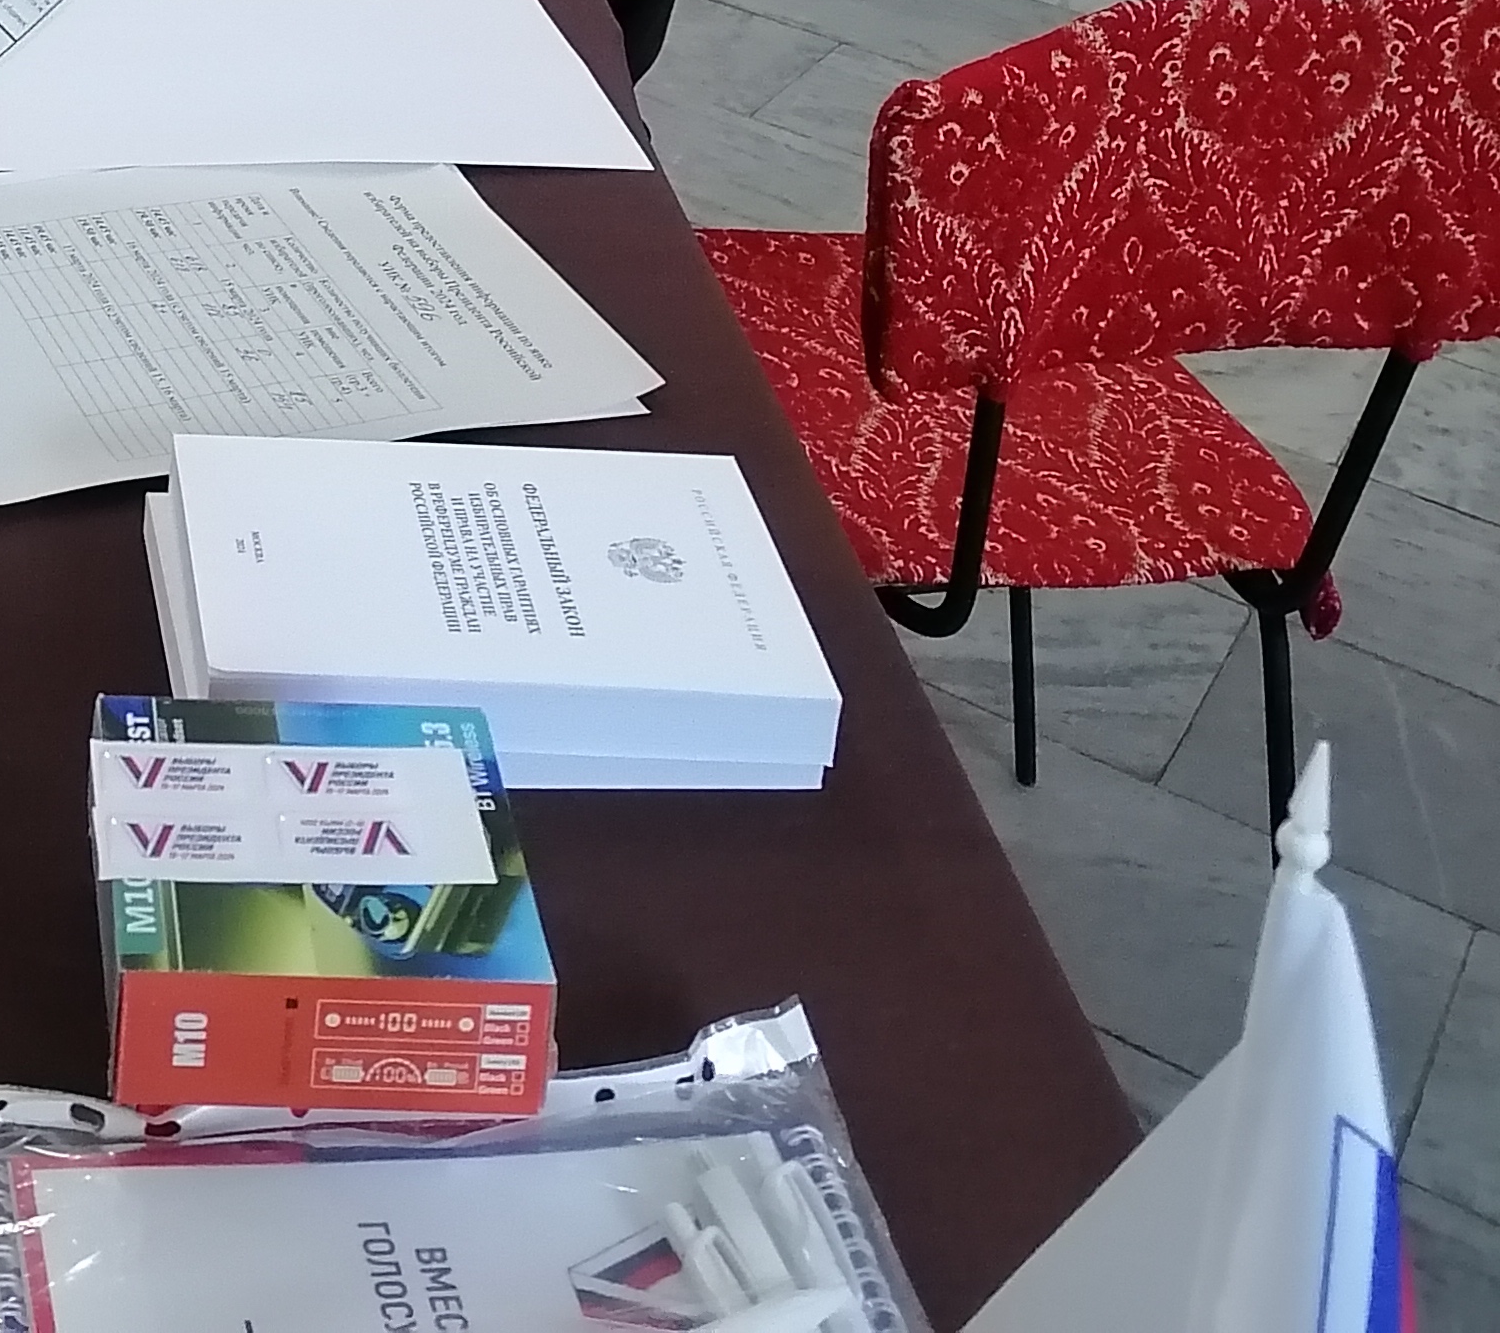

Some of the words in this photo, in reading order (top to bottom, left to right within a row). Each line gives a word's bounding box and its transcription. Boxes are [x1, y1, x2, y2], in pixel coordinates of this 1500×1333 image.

[363, 191, 414, 238] избирателей
[405, 238, 421, 248] на
[415, 249, 450, 280] выборы
[444, 280, 494, 329] Президента
[488, 328, 542, 381] Российской
[377, 261, 404, 282] УИК
[388, 195, 416, 221] Форма
[411, 221, 474, 283] предоставления
[468, 282, 523, 335] информации
[516, 335, 534, 348] по
[392, 243, 436, 289] Федерации
[429, 289, 458, 309] 2024
[427, 482, 442, 490] В
[483, 482, 500, 498] ОБ
[408, 482, 445, 558] РОССИЙСКОЙ
[431, 560, 462, 633] ФЕДЕРАЦИИ
[429, 492, 466, 574] РЕФЕРЕНДУМЕ
[452, 507, 475, 544] ПРАВА
[464, 545, 480, 562] НА
[467, 492, 509, 590] ИЗБИРАТЕЛЬНЫХ
[496, 591, 518, 623] ПРАВ
[488, 499, 521, 565] ОСНОВНЫХ
[469, 564, 498, 617] УЧАСТИЕ
[522, 483, 572, 584] ФЕДЕРАЛЬНЫЙ
[555, 586, 586, 637] ЗАКОН
[690, 489, 734, 568] РОССИЙСКАЯ
[726, 572, 768, 651] ФЕДЕРАЦИЯ
[453, 576, 482, 633] ГРАЖДАН
[508, 567, 542, 635] ГАРАНТИЯХ
[125, 711, 151, 741] ST
[171, 1011, 209, 1068] M10
